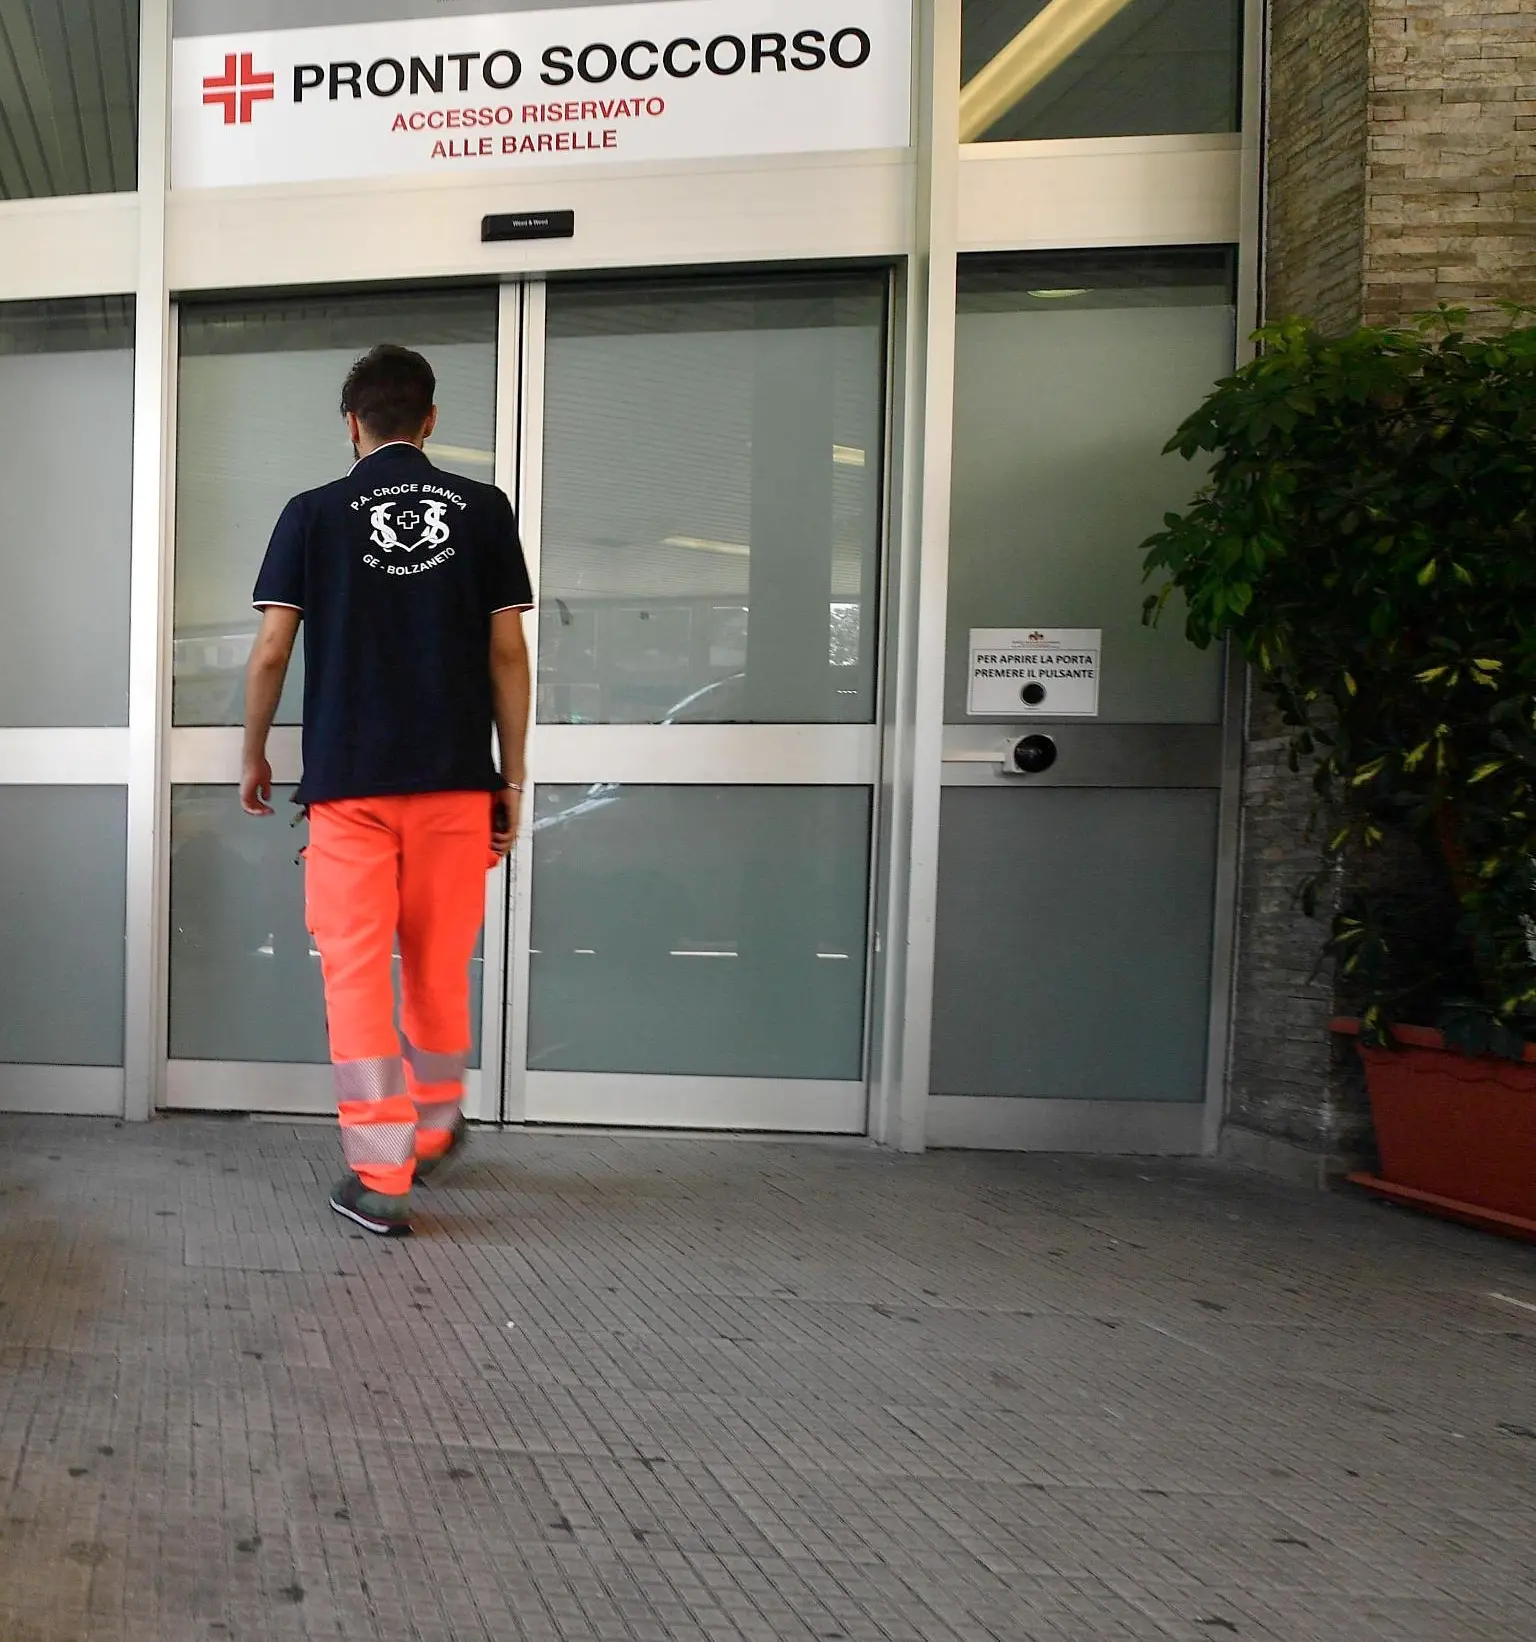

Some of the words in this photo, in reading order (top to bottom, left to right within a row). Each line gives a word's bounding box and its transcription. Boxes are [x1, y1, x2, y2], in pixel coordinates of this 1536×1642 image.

[292, 50, 522, 103] PRONTO
[539, 26, 872, 87] SOCCORSO
[390, 106, 515, 132] ACCESSO
[521, 96, 665, 123] RISERVATO
[430, 135, 493, 159] ALLE
[501, 128, 618, 154] BARELLE
[350, 495, 372, 511] P.A.
[373, 483, 419, 497] CROCE
[421, 484, 467, 511] BIANCA
[362, 554, 380, 568] GE
[386, 547, 456, 576] BOLZANETO
[975, 669, 1024, 678] PREMERE
[1027, 669, 1037, 678] IL
[1039, 669, 1094, 679] PULSANTE
[977, 655, 997, 664] PER
[1000, 655, 1038, 664] APRIRE
[1040, 655, 1053, 664] LA
[1056, 655, 1093, 664] PORTA
